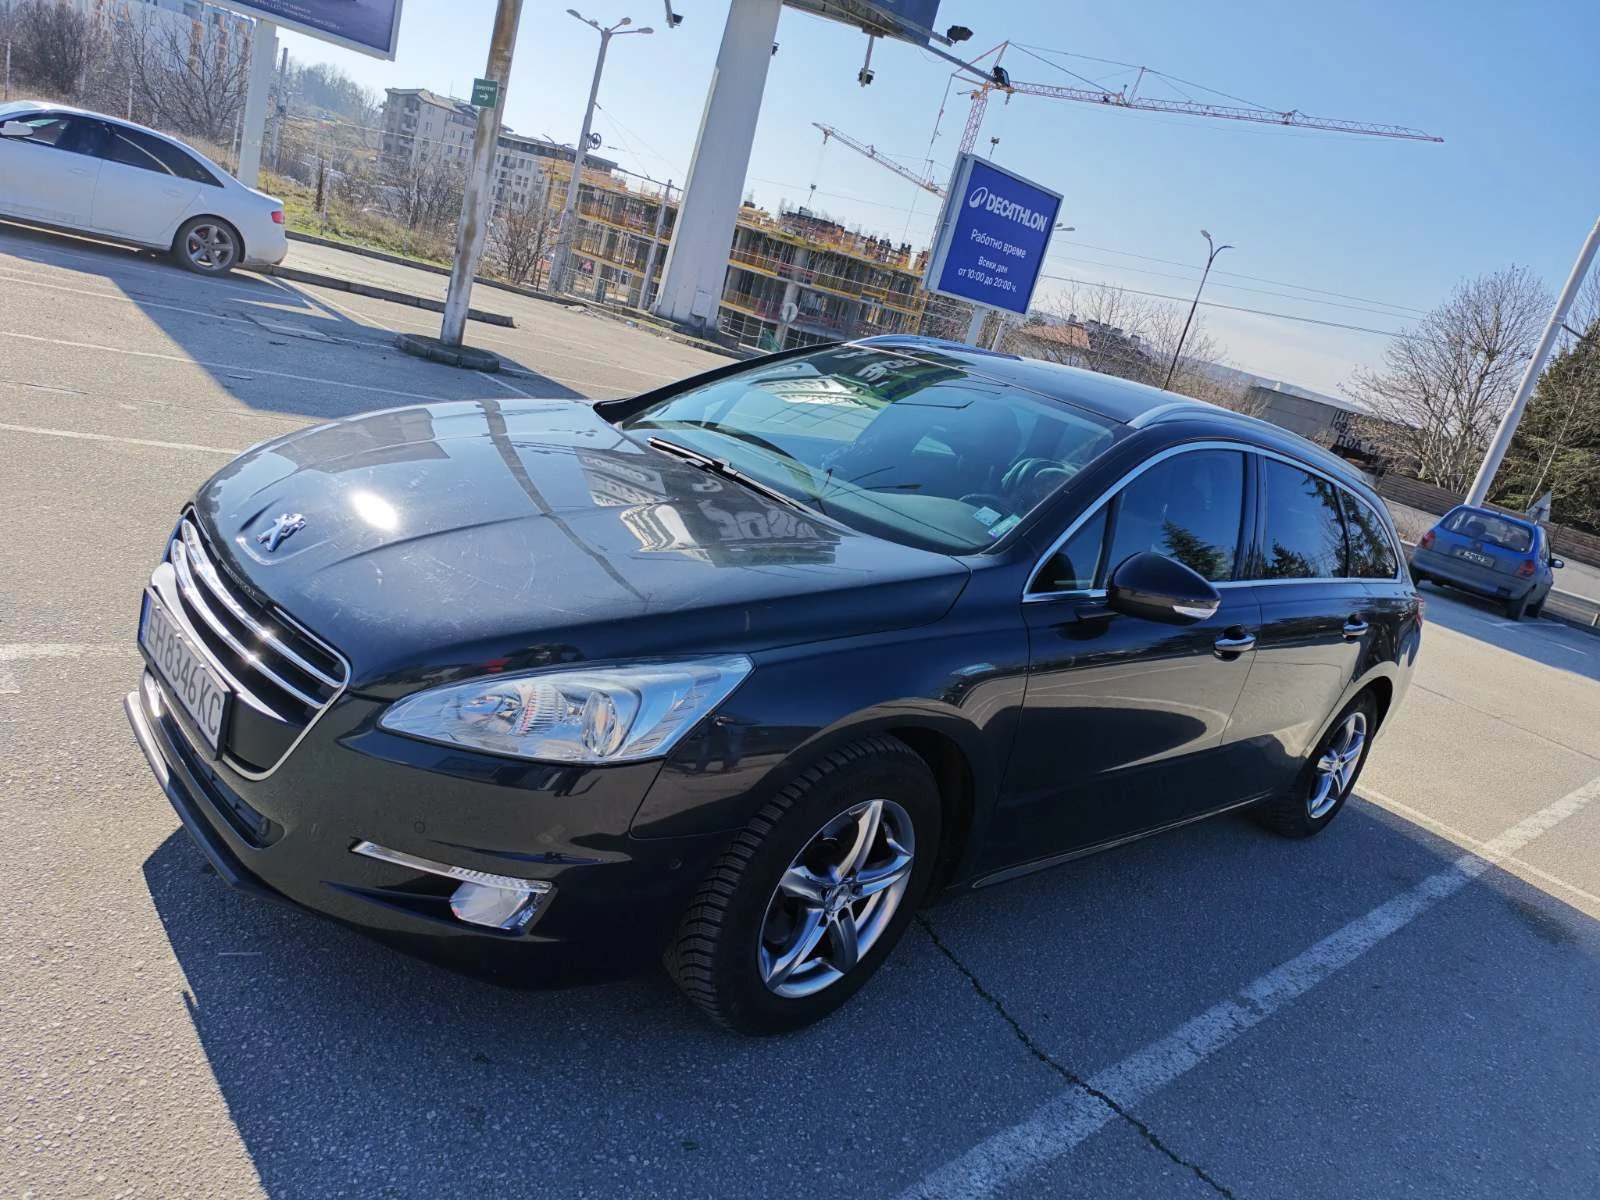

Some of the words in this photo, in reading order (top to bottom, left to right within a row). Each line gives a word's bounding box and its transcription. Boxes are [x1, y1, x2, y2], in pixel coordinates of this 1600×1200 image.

[985, 194, 1048, 233] DECATHLON
[970, 228, 1003, 250] Работно
[1003, 242, 1027, 259] време
[978, 256, 996, 271] Всеки
[996, 265, 1009, 274] ден
[958, 268, 967, 277] от
[967, 268, 984, 283] 10:00
[984, 275, 993, 286] до
[993, 279, 1011, 291] 20:00
